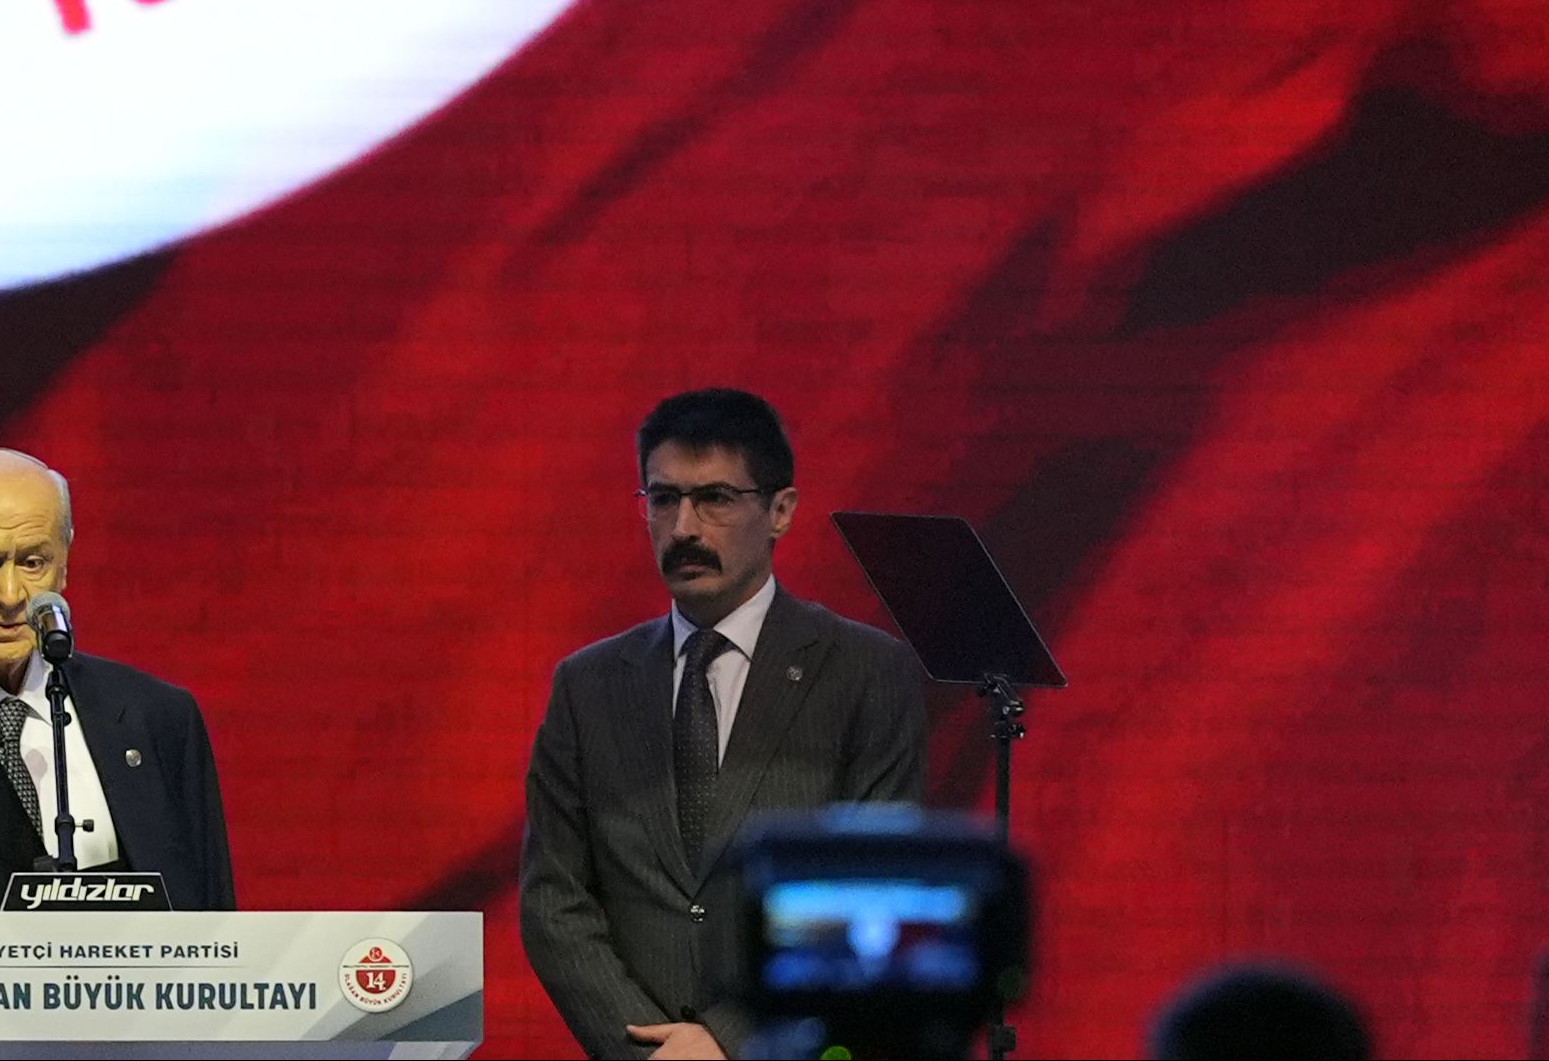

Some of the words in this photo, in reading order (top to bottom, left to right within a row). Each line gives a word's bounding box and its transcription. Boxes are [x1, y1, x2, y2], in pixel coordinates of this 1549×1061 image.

[59, 945, 153, 958] HAREKET
[160, 942, 239, 958] PARTİSİ
[43, 974, 145, 1010] BÜYÜK
[155, 982, 317, 1010] KURULTAYI
